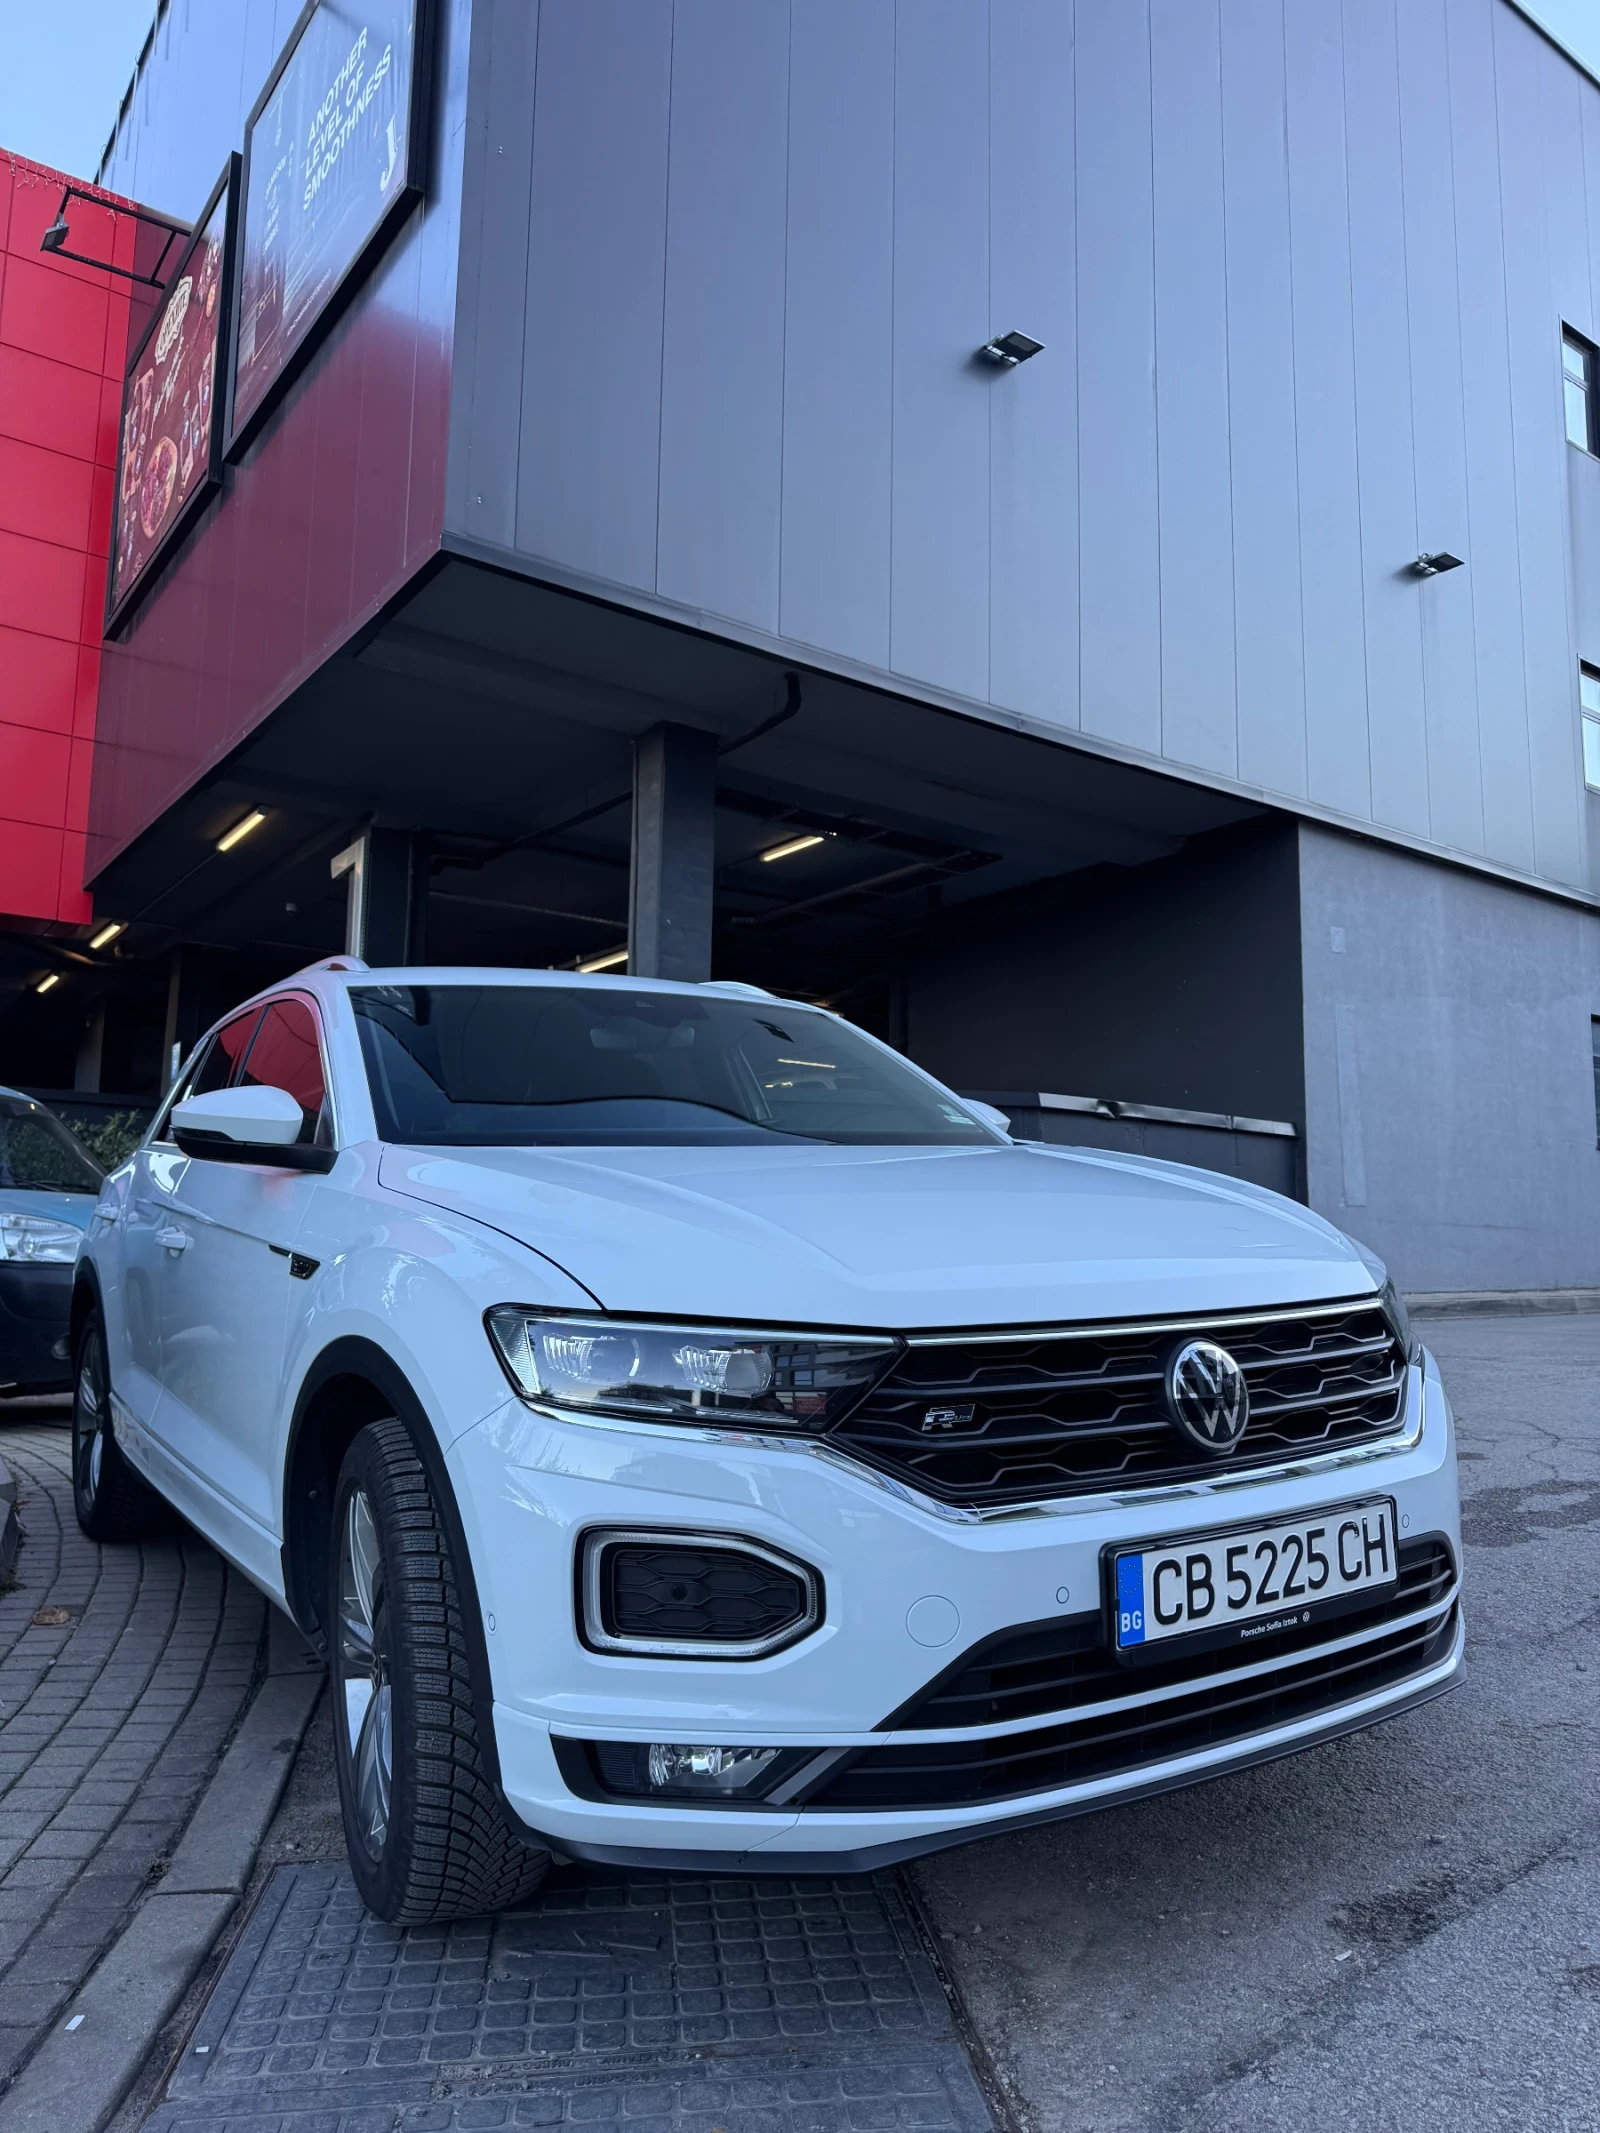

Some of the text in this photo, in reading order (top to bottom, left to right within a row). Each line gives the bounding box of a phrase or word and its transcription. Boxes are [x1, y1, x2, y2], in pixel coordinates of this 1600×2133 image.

[303, 44, 391, 210] SMOOTHNESS
[305, 60, 364, 180] LEVEL OF
[308, 26, 367, 148] ANOTHER
[1121, 1611, 1142, 1633] BG
[1153, 1513, 1389, 1625] CB 5225 CH
[1241, 1625, 1265, 1638] Porsche
[1266, 1621, 1282, 1632] Sofia
[1283, 1616, 1298, 1627] Iztok
